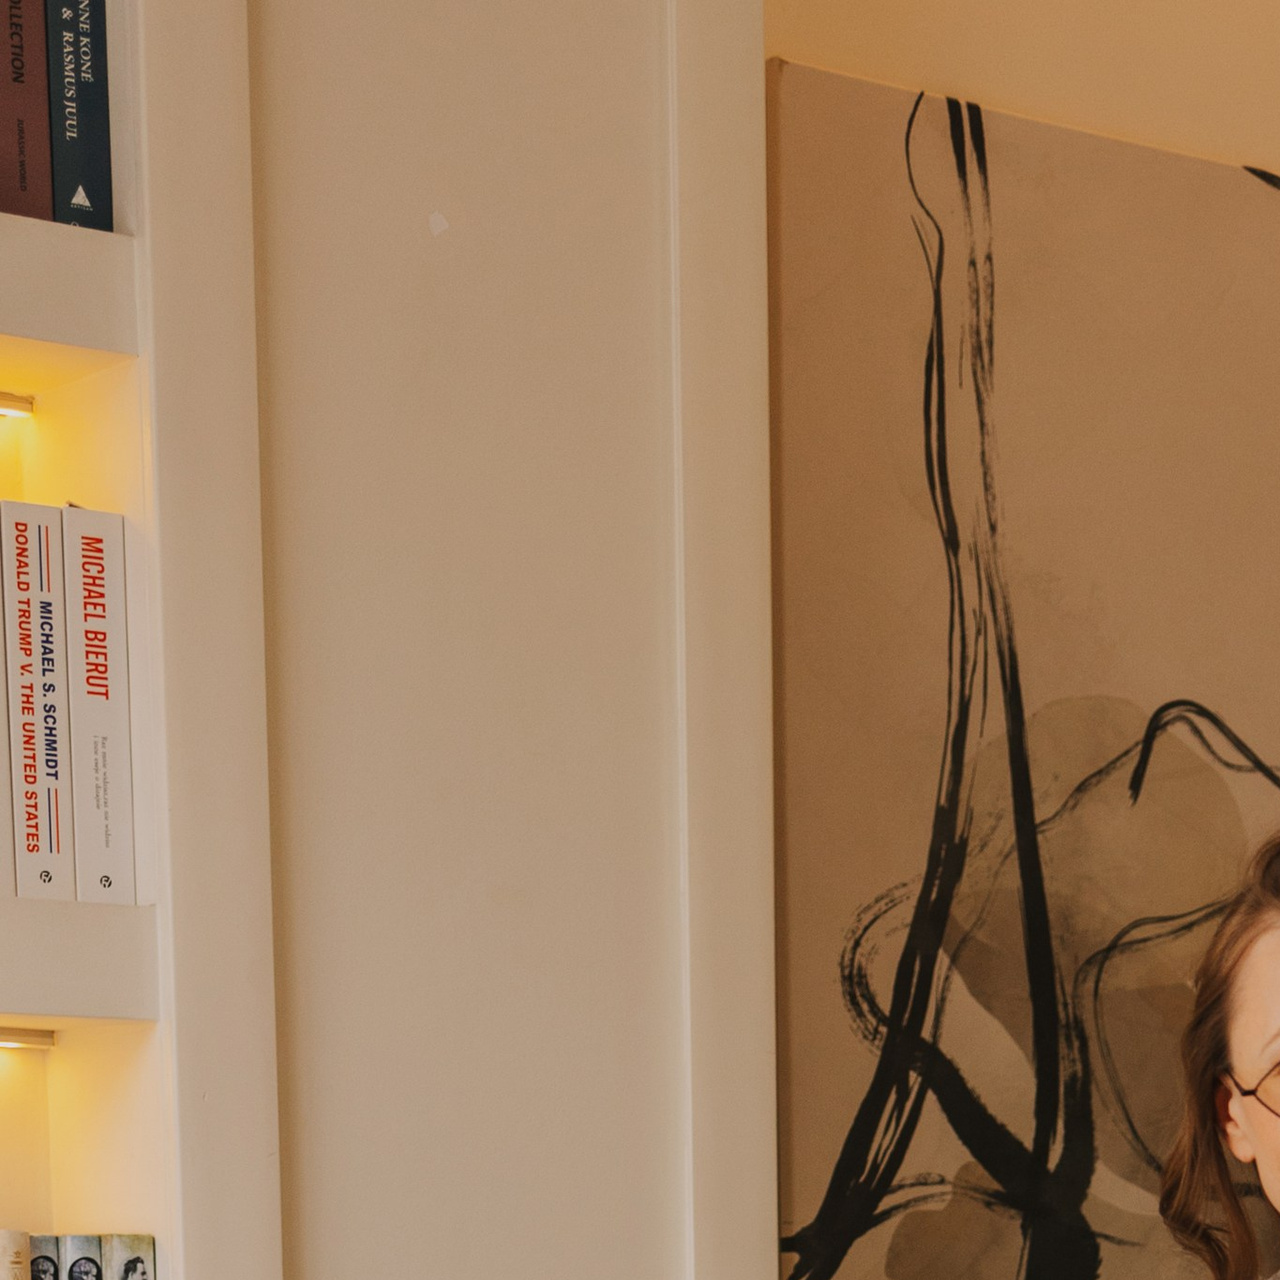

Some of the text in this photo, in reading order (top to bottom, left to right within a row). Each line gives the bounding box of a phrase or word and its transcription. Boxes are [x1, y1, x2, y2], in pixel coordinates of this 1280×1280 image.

[62, 8, 77, 141] & RASMUS JUUL
[80, 36, 94, 82] KONÉ
[15, 522, 39, 853] DONALD TRUMP V. THE UNITED STATES
[39, 601, 58, 780] MICHAEL S. SCHMIDT
[81, 535, 109, 700] MICHAEL BIERUT
